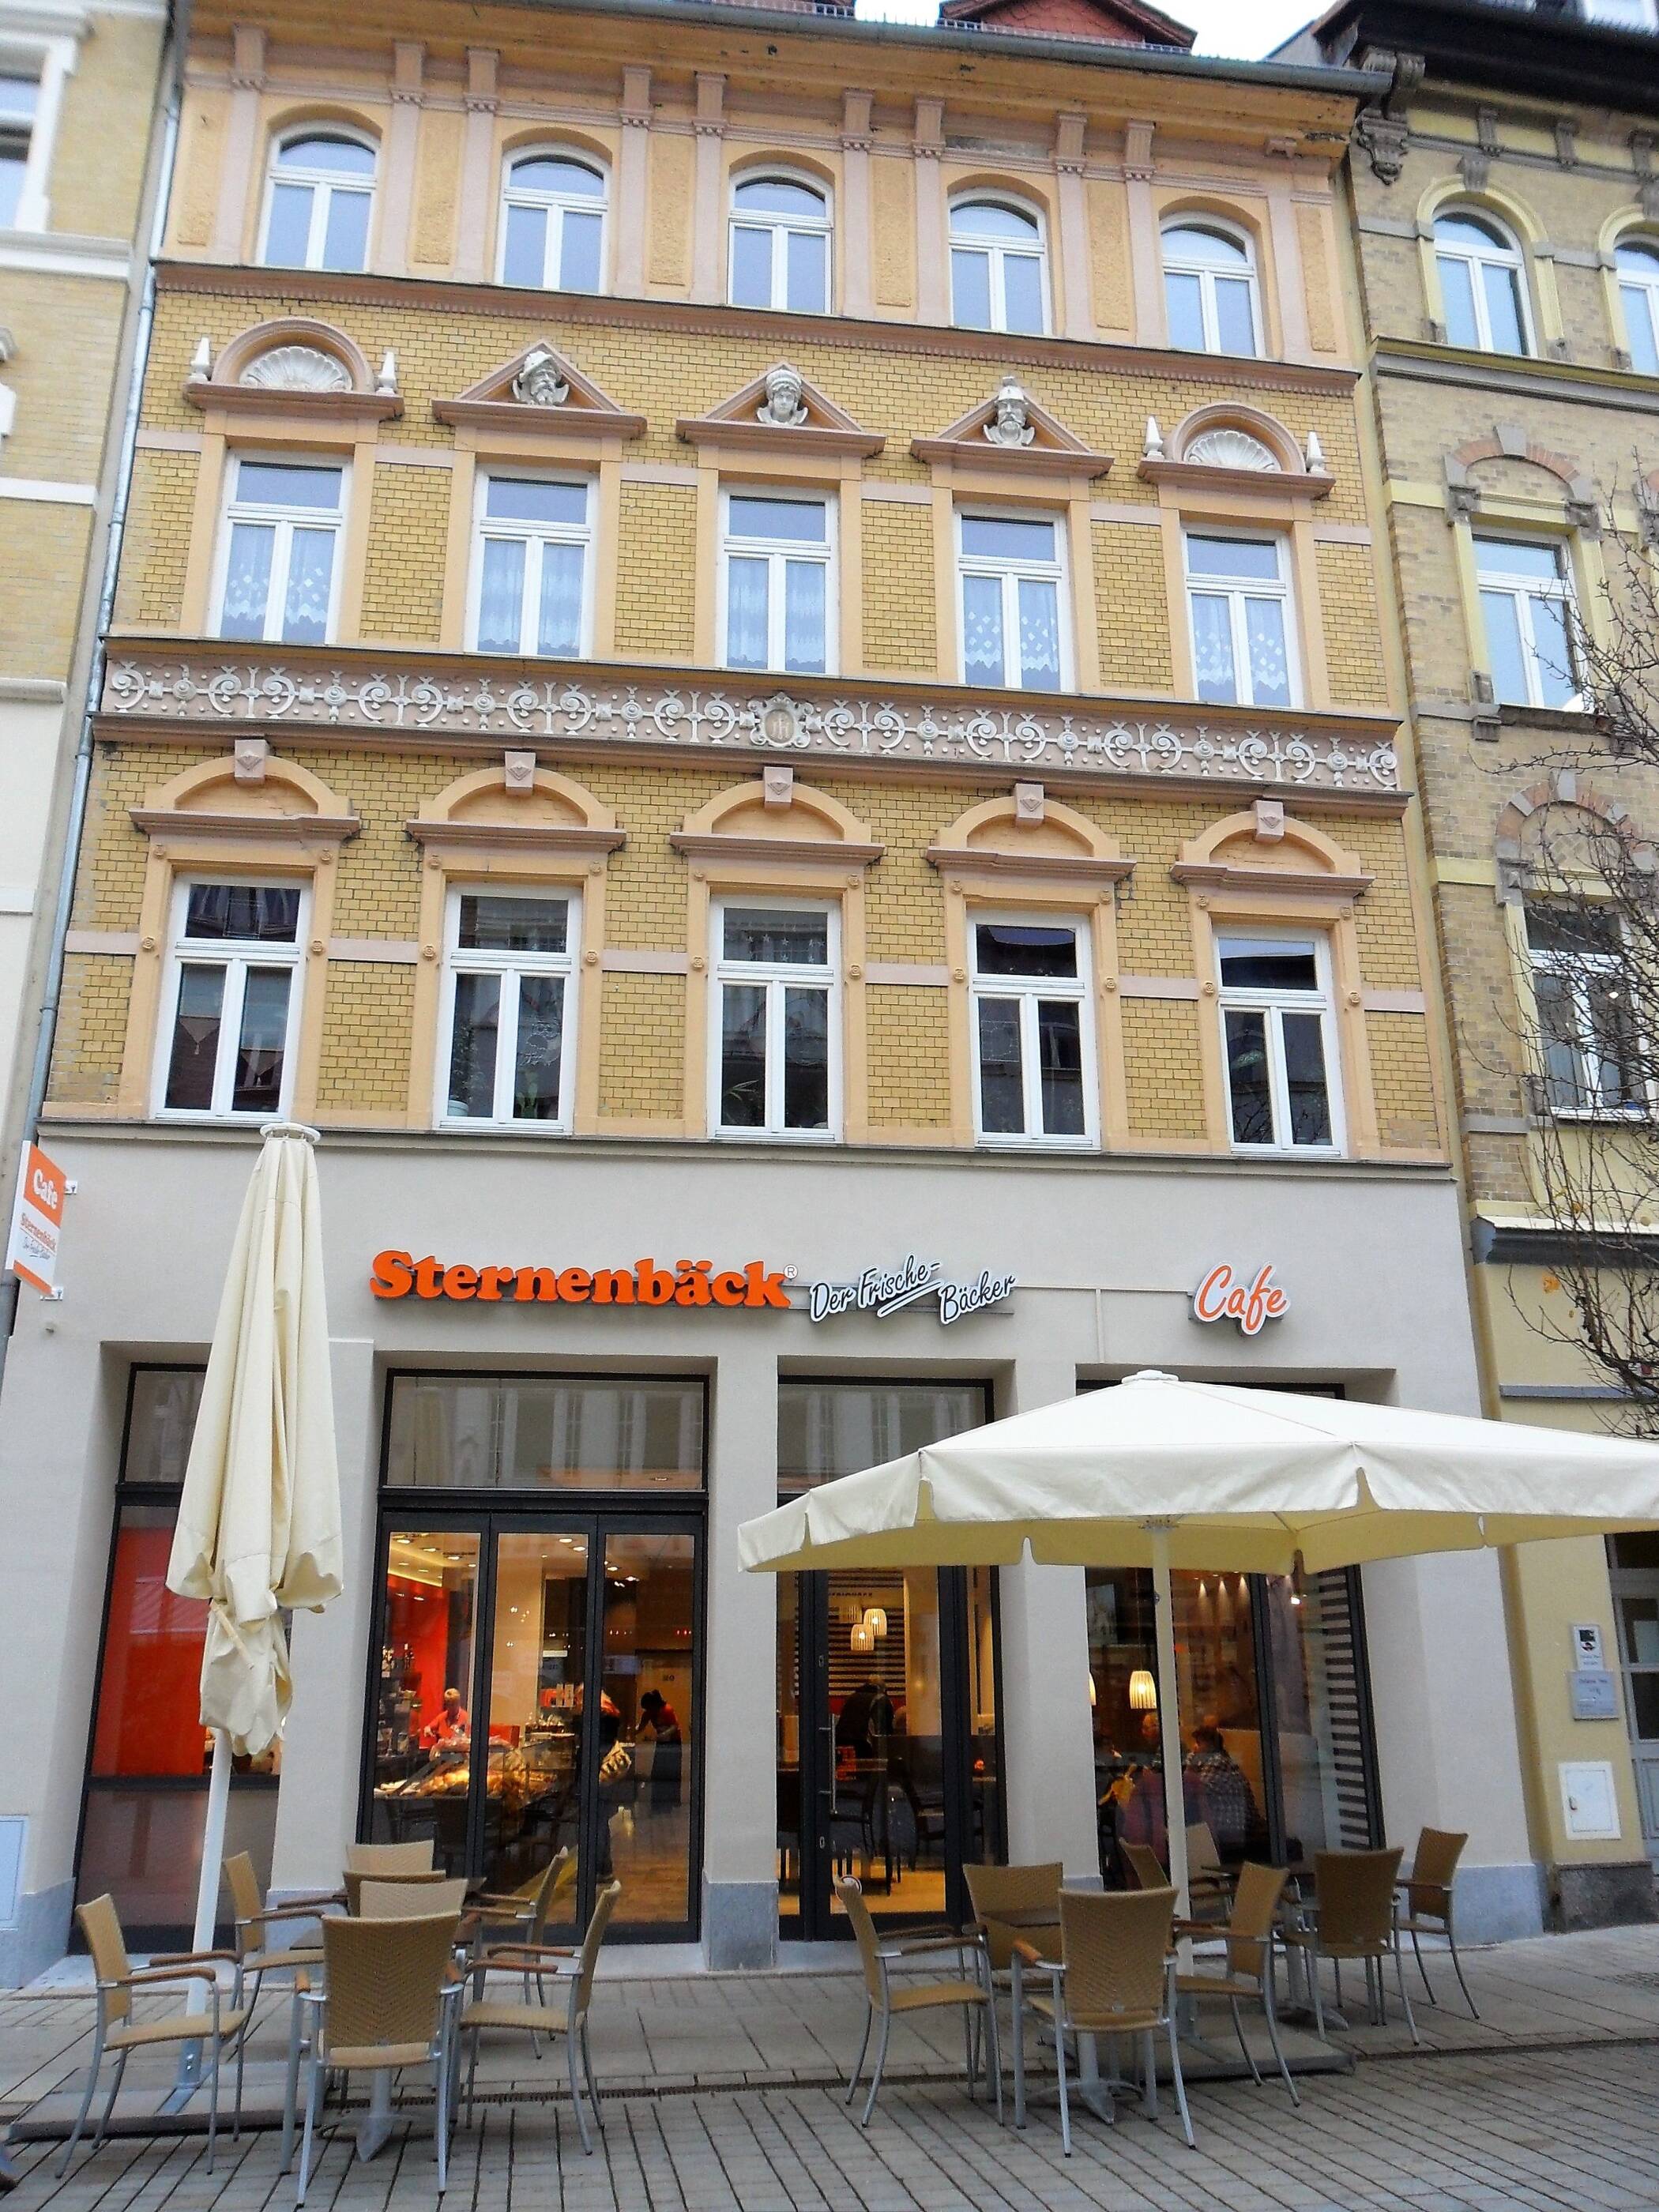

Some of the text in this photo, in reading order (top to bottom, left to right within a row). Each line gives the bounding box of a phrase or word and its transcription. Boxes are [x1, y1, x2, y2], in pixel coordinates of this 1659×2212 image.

[369, 1249, 791, 1308] Sternenbäck
[811, 1254, 1017, 1323] Der Frische- Bäcker
[1198, 1264, 1288, 1332] Cafe
